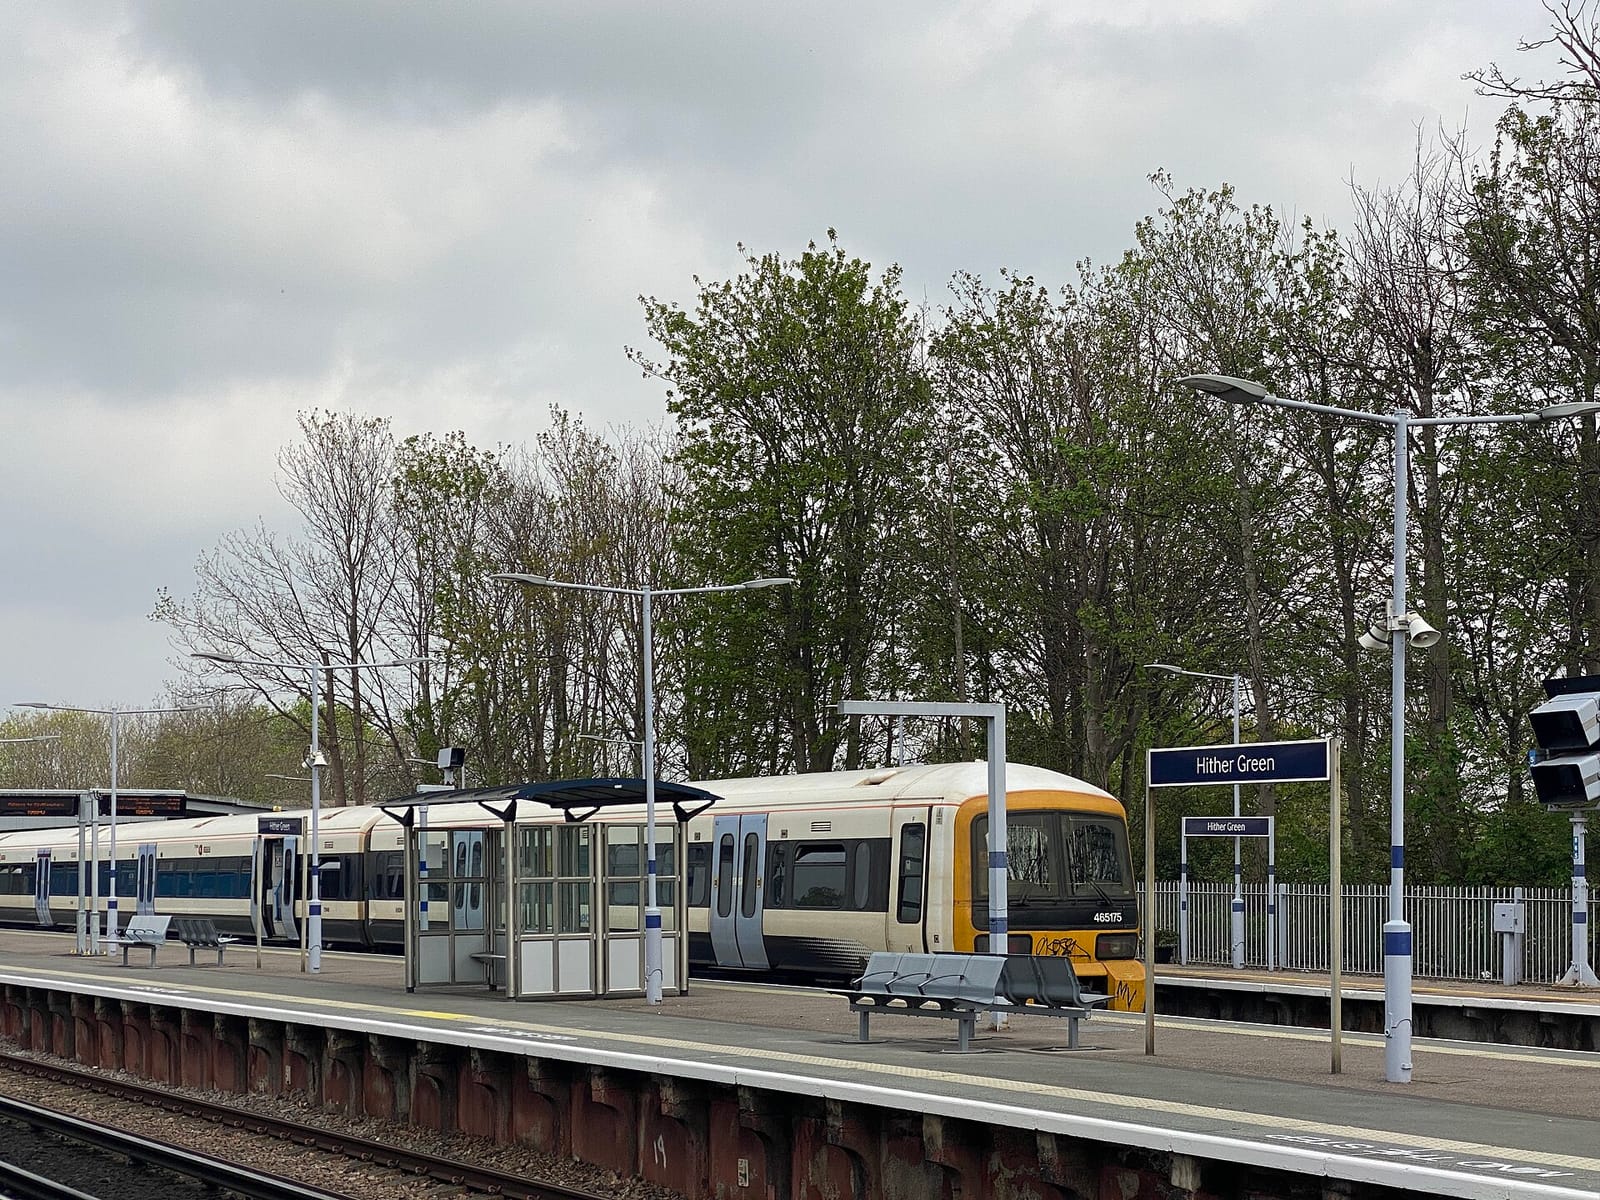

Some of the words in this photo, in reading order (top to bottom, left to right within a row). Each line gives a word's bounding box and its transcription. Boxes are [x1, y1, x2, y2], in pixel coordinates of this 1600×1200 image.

[1196, 757, 1235, 775] Hither
[1237, 754, 1275, 773] Green
[1207, 821, 1227, 831] Hither
[1227, 821, 1246, 832] Green
[1093, 912, 1123, 923] 465175
